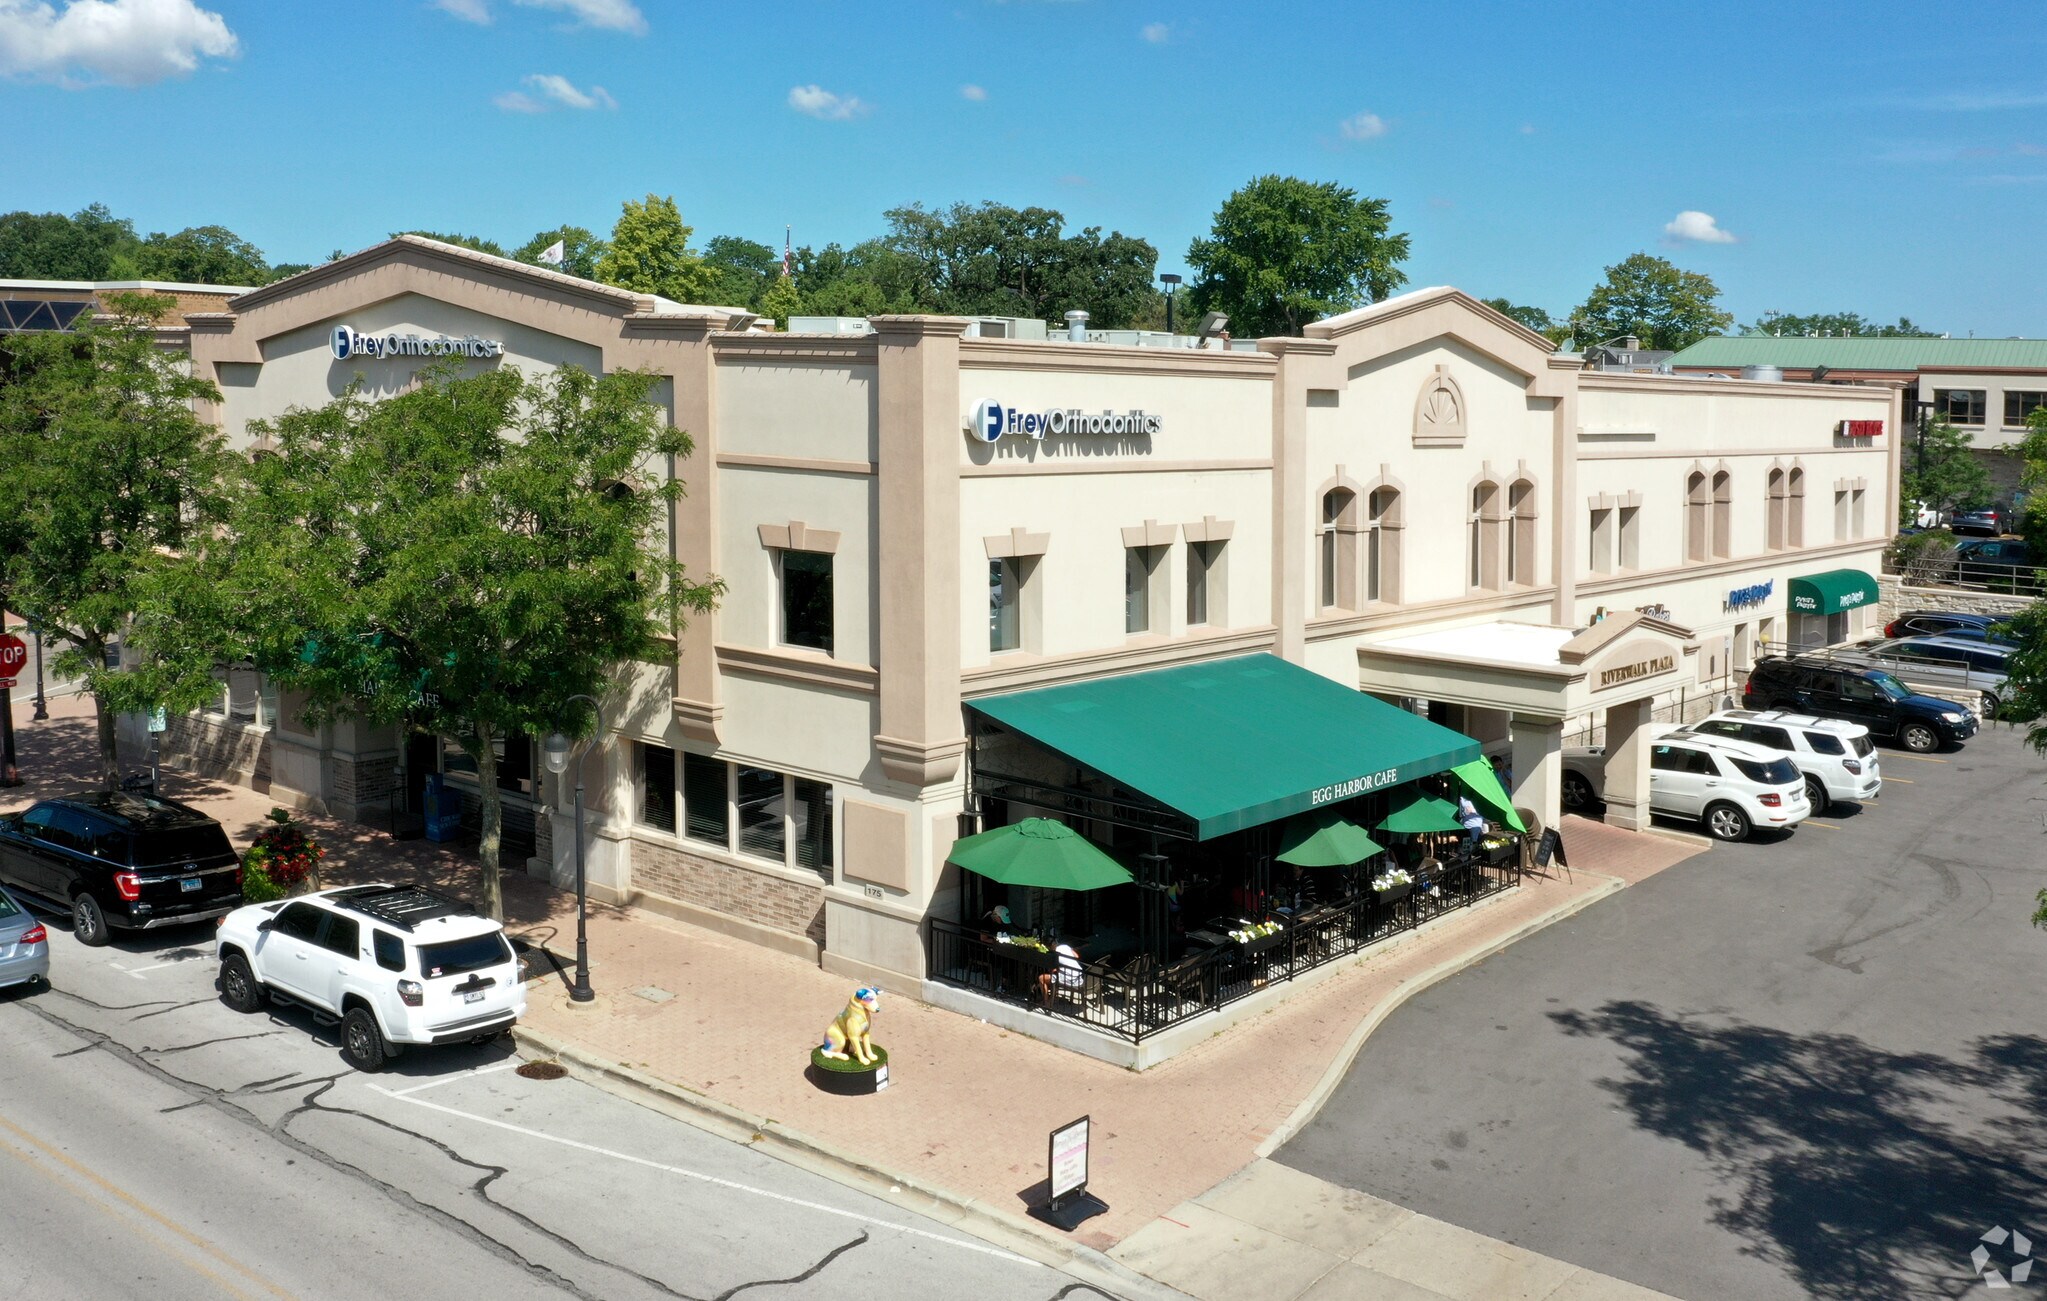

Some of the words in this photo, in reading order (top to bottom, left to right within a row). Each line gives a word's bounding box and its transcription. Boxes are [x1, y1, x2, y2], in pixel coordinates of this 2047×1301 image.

[353, 333, 386, 359] Frey
[386, 333, 493, 358] Orthodontics
[1007, 408, 1049, 440] Frey
[1049, 409, 1162, 434] Orthodontics
[1600, 661, 1648, 687] RIVERWALK
[1649, 655, 1674, 674] PLAZA
[1312, 787, 1332, 805] EGG
[1334, 775, 1373, 799] HARBOR
[1374, 768, 1397, 787] CAFE
[867, 887, 882, 898] 175
